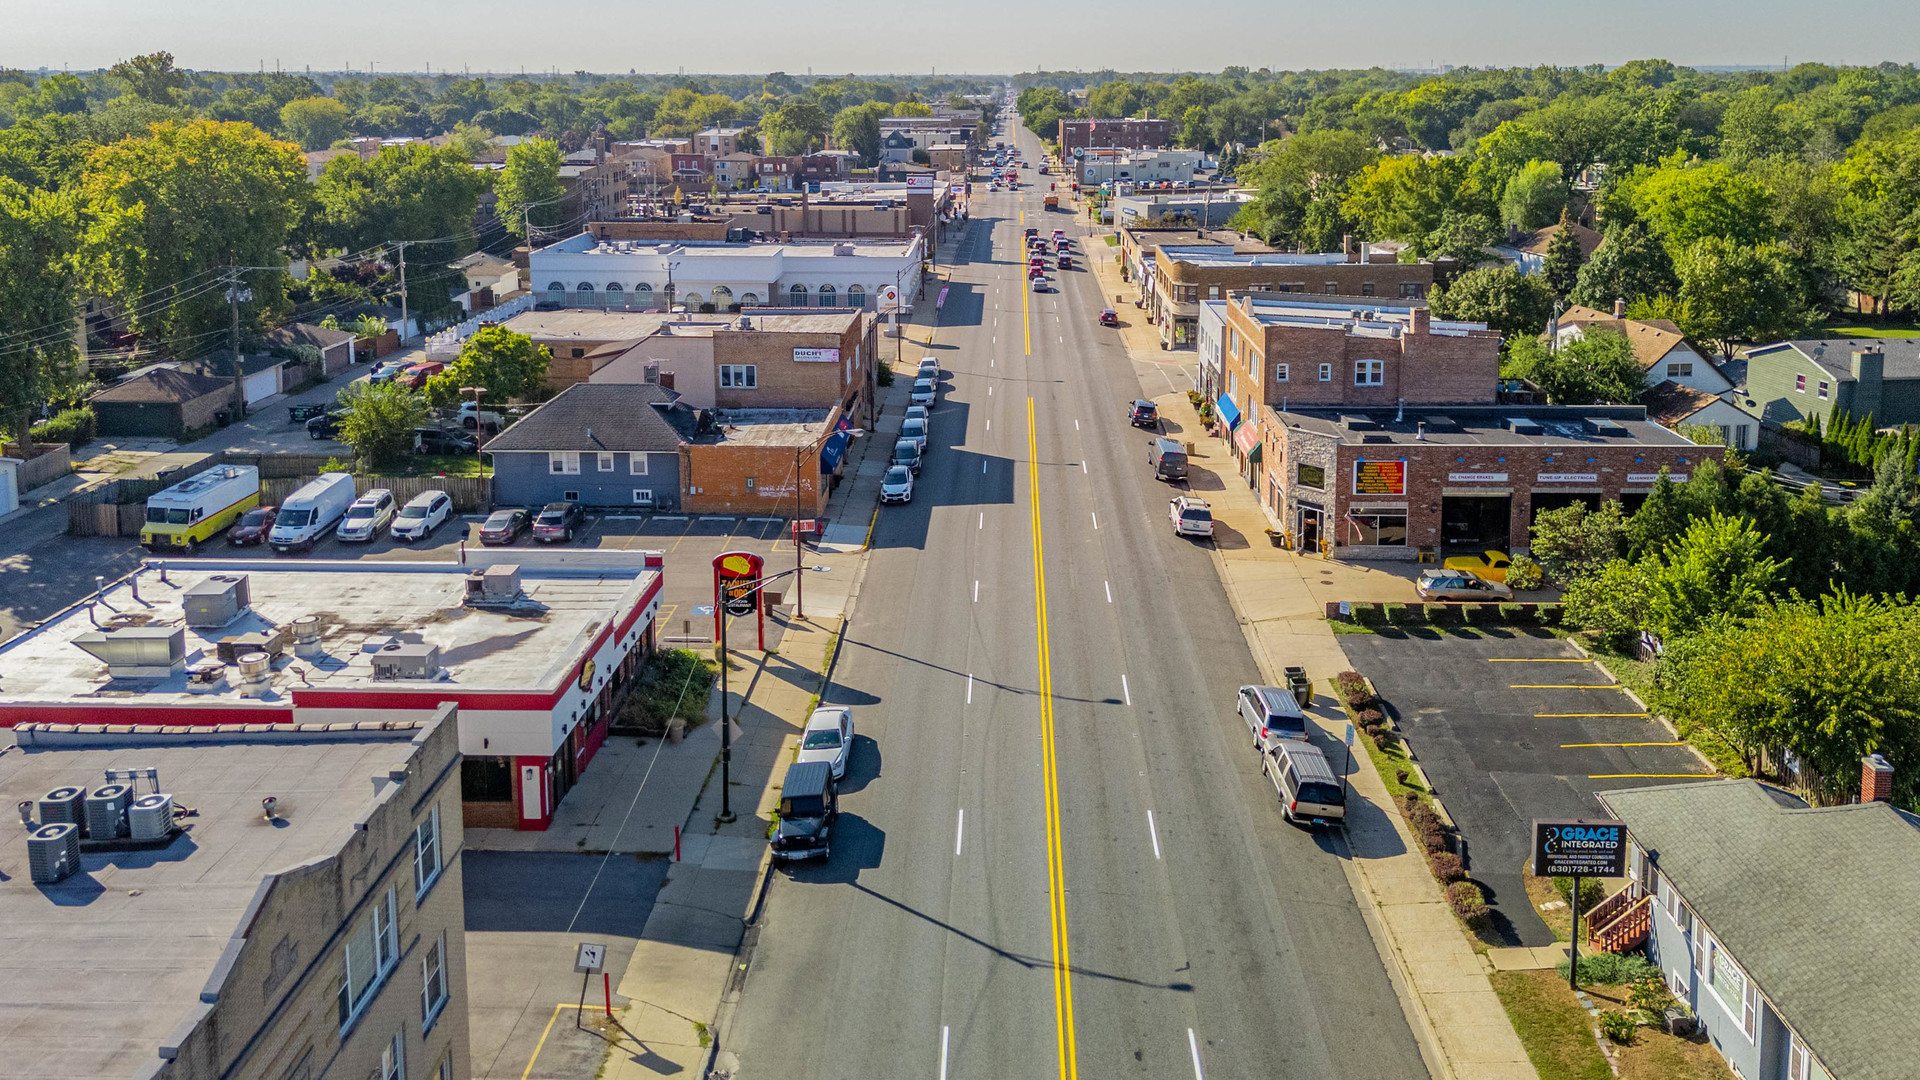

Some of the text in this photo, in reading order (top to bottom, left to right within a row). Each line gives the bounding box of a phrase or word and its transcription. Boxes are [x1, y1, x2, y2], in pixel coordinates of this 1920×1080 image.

[1561, 827, 1619, 841] GRACE
[1561, 840, 1618, 849] INTEGRATED
[1547, 865, 1615, 874] (630)728-1744
